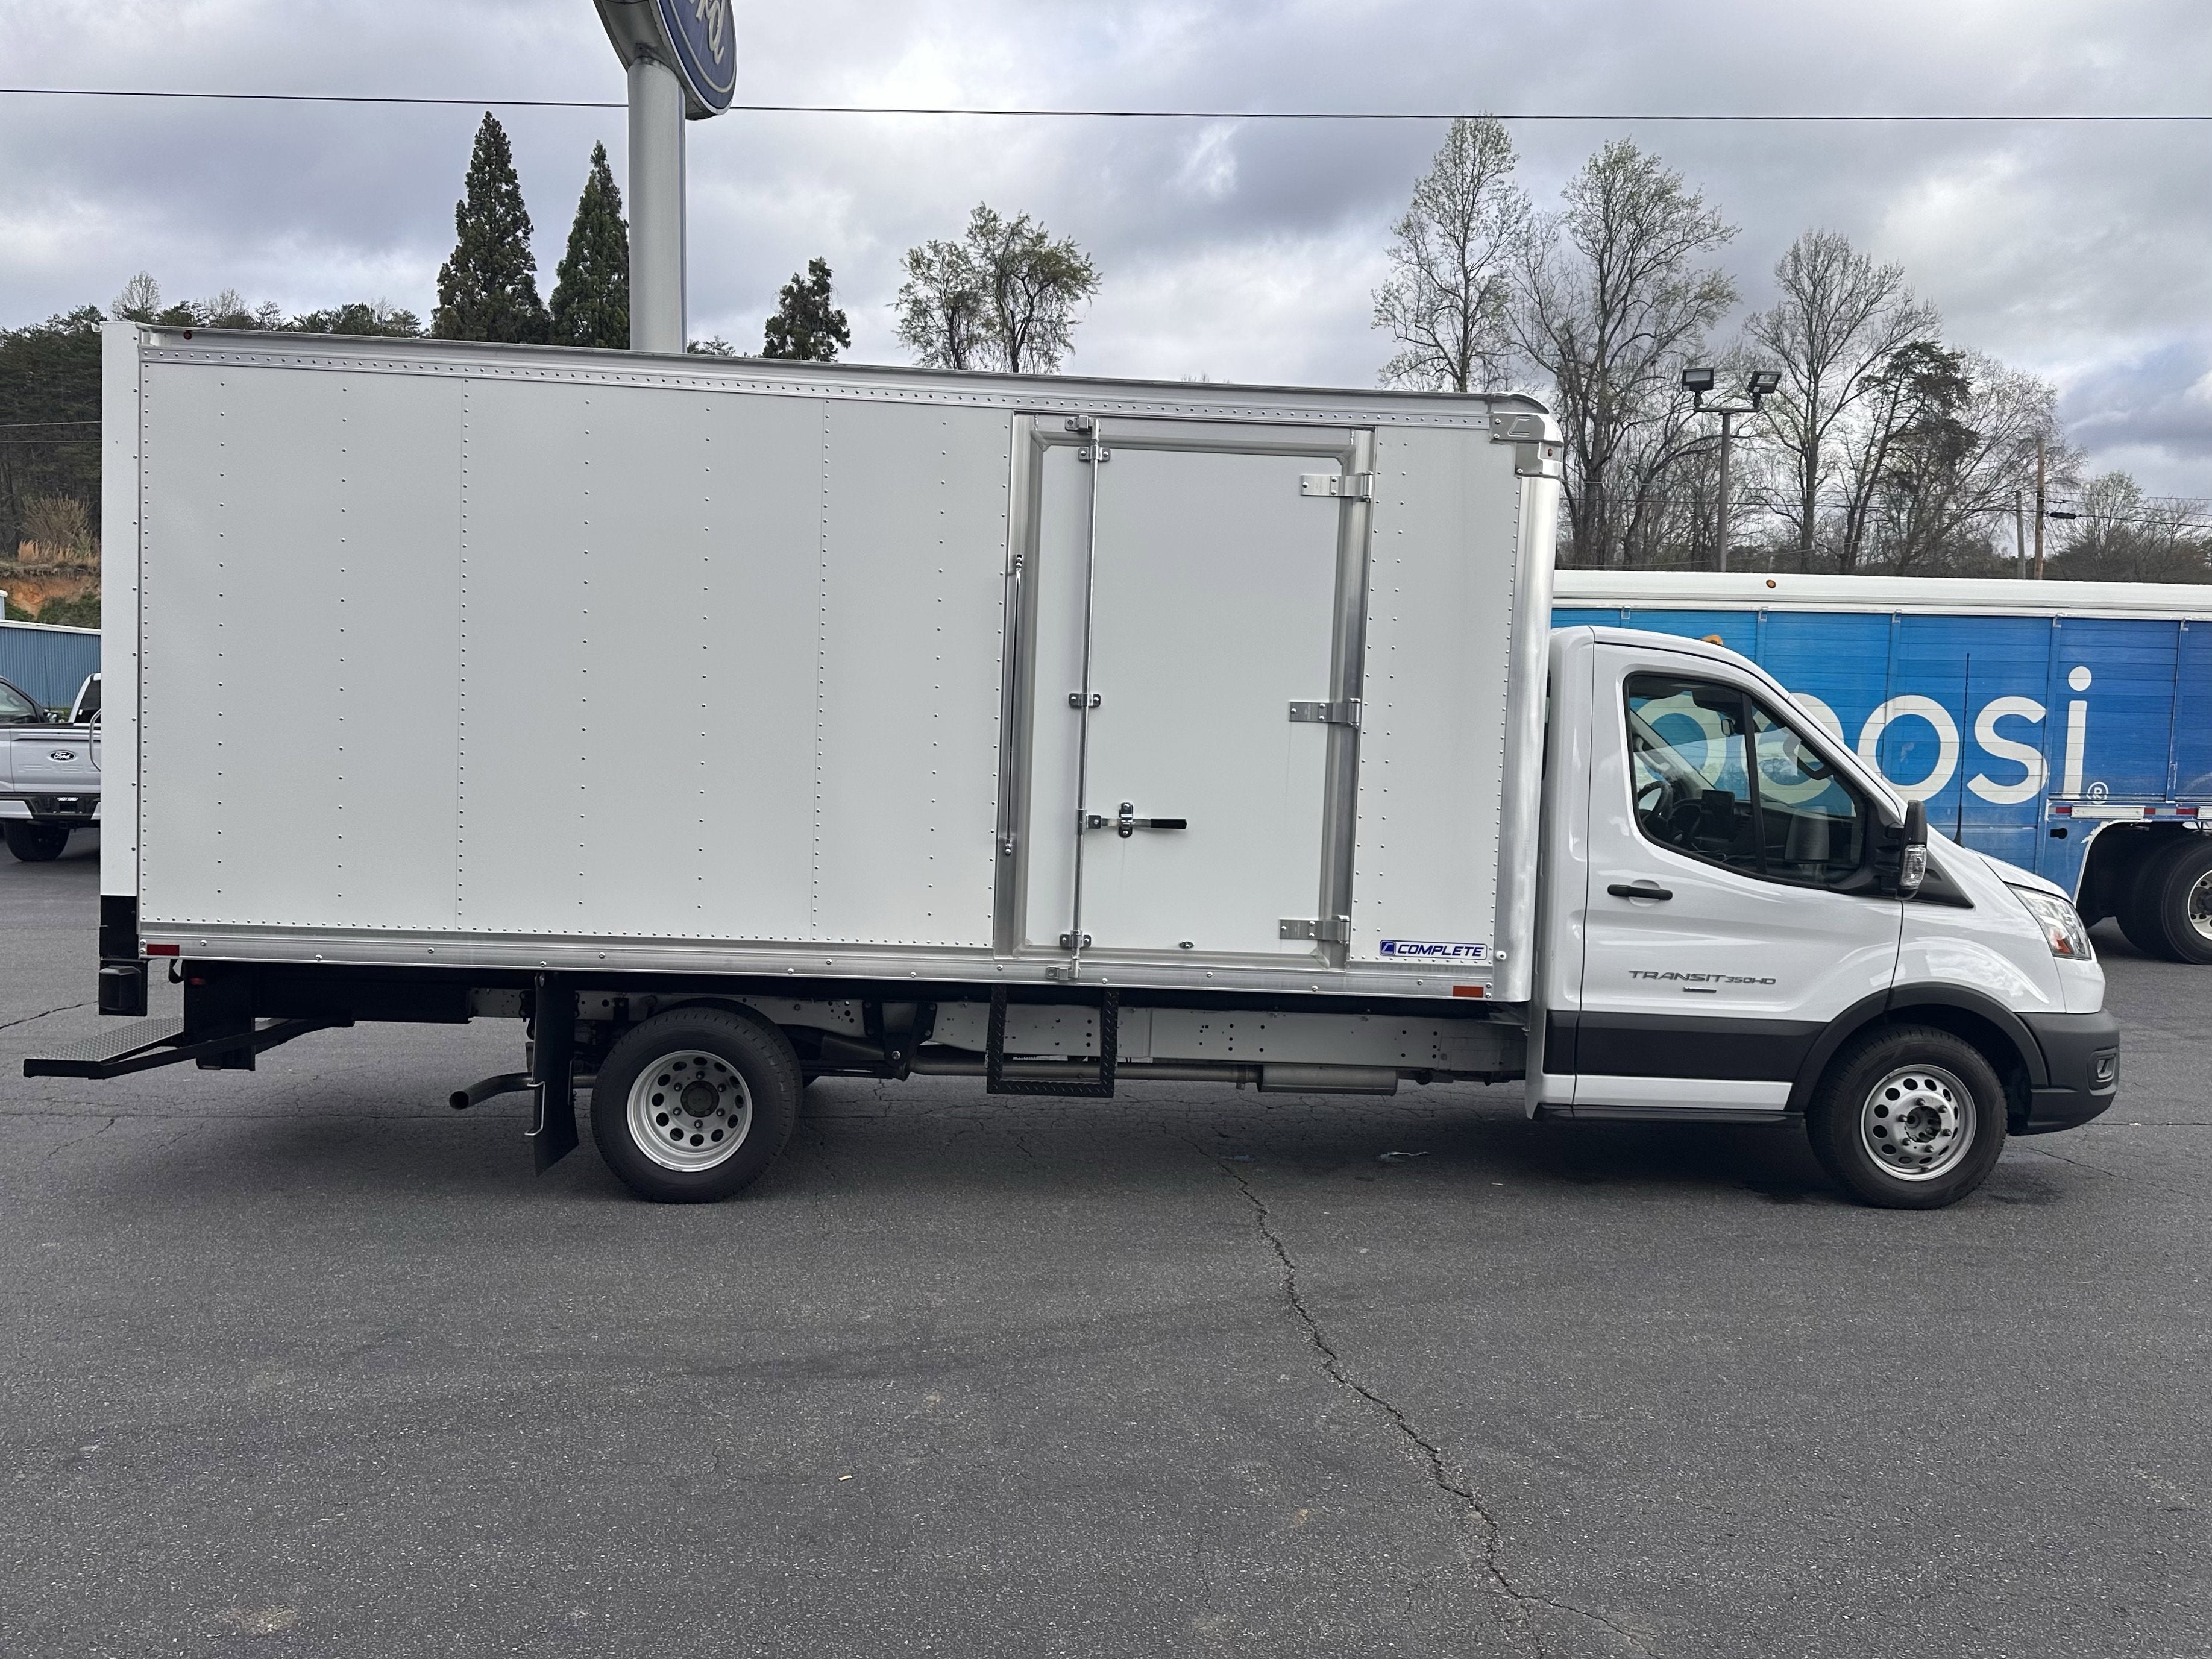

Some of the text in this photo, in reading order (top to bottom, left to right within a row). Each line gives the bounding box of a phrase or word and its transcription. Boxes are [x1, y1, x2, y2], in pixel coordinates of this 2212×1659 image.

[1397, 944, 1484, 957] COMPLETE
[1629, 970, 1776, 985] TRANSIT 350HD
